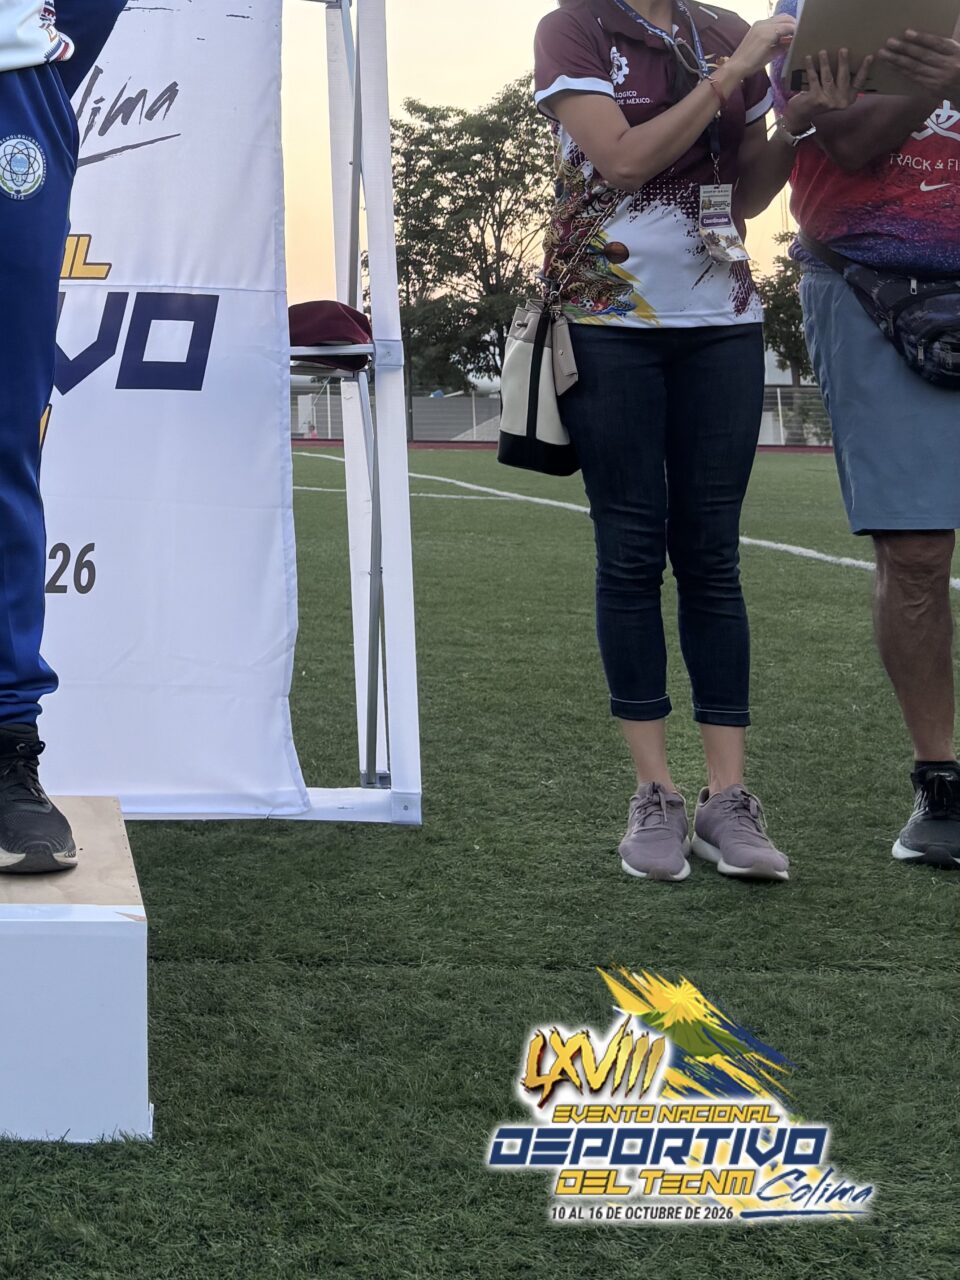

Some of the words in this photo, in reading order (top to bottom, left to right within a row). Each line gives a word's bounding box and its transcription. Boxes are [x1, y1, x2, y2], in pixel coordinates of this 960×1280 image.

[75, 64, 180, 148] lima
[615, 90, 637, 98] LOGICO
[889, 153, 932, 172] TRACK
[934, 160, 944, 170] &
[45, 542, 96, 595] 26
